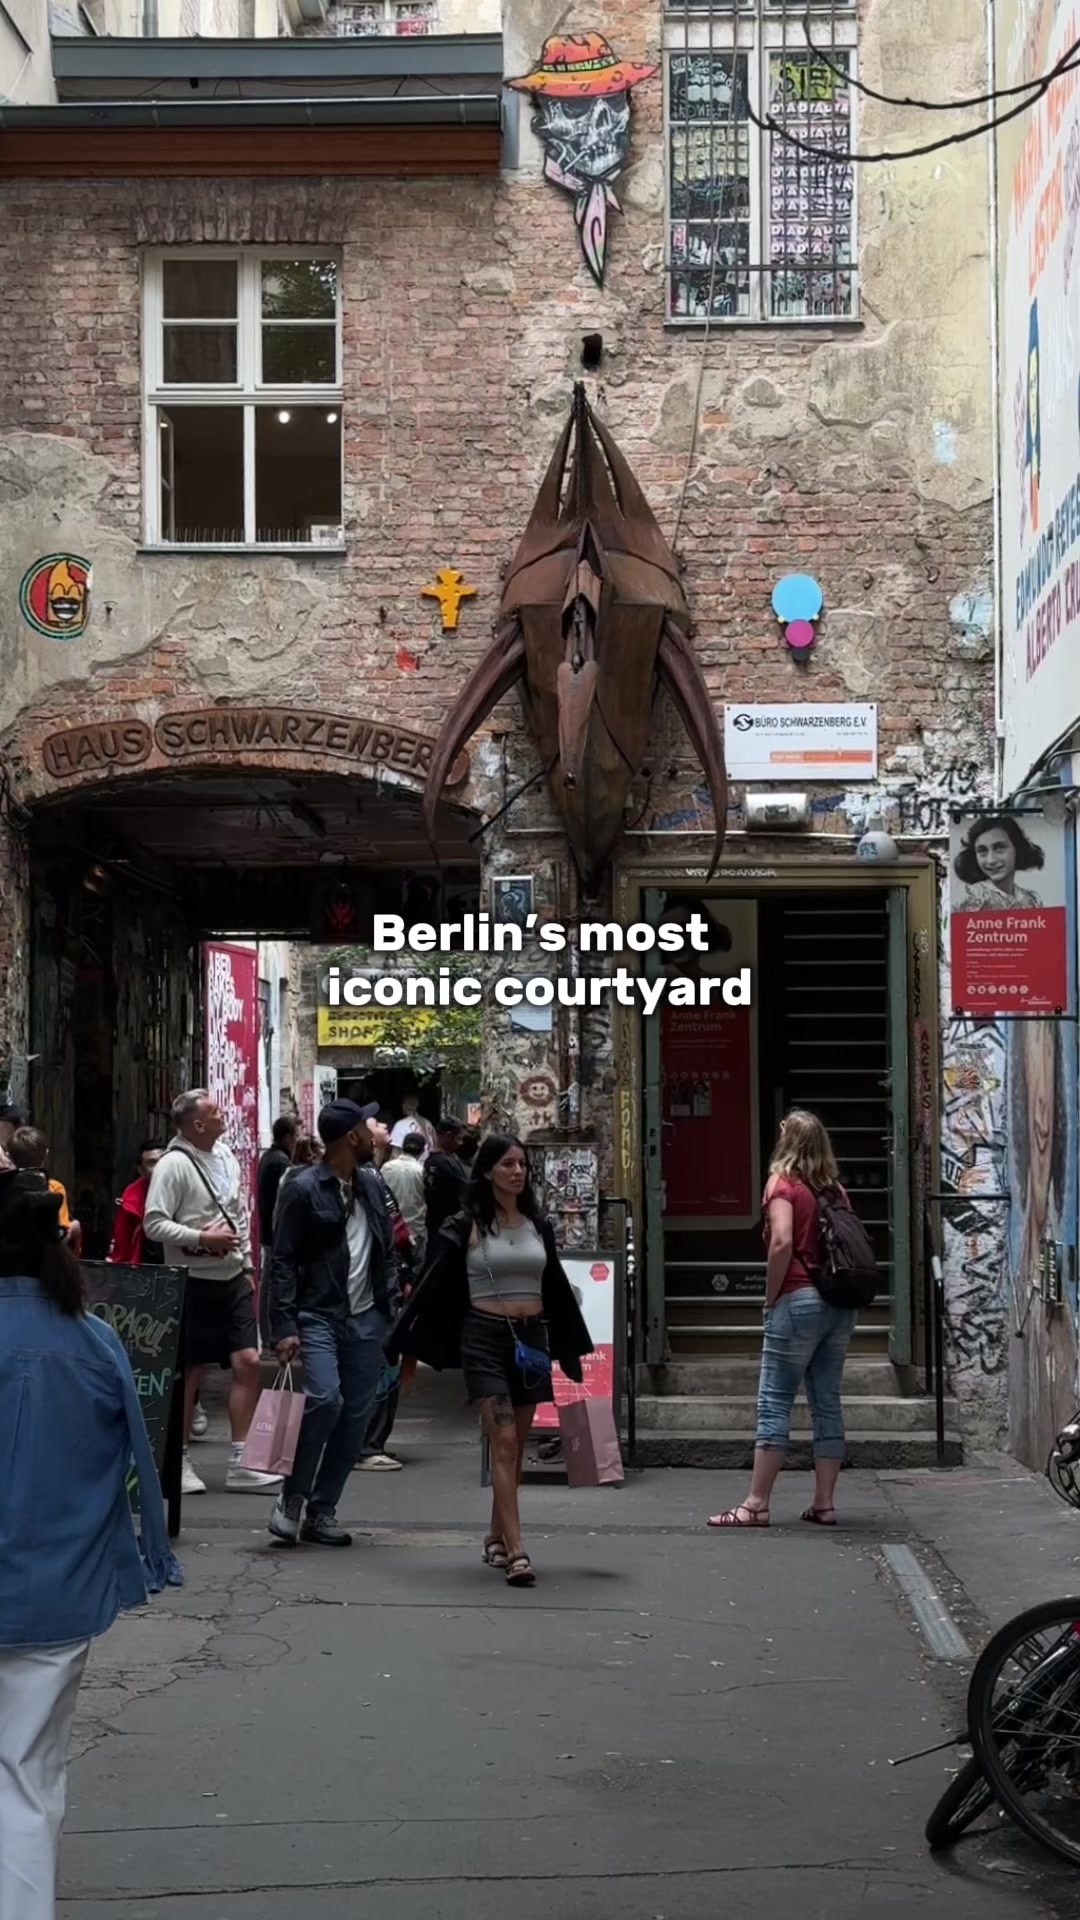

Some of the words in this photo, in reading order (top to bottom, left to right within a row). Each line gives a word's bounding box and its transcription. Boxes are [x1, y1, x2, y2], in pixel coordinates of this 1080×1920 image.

[1026, 579, 1062, 683] ALBERTO
[755, 715, 778, 728] BÜRO
[780, 716, 852, 728] SCHWARZENBERG
[853, 717, 868, 728] E.V.
[49, 728, 143, 770] HAUS
[162, 714, 434, 772] SCHWARZENBER
[966, 917, 1003, 929] Anne
[1006, 915, 1047, 928] Frank
[966, 931, 1028, 943] Zentrum
[671, 1010, 701, 1020] Anne
[704, 1009, 736, 1020] Frank
[671, 1022, 722, 1032] Zentrum
